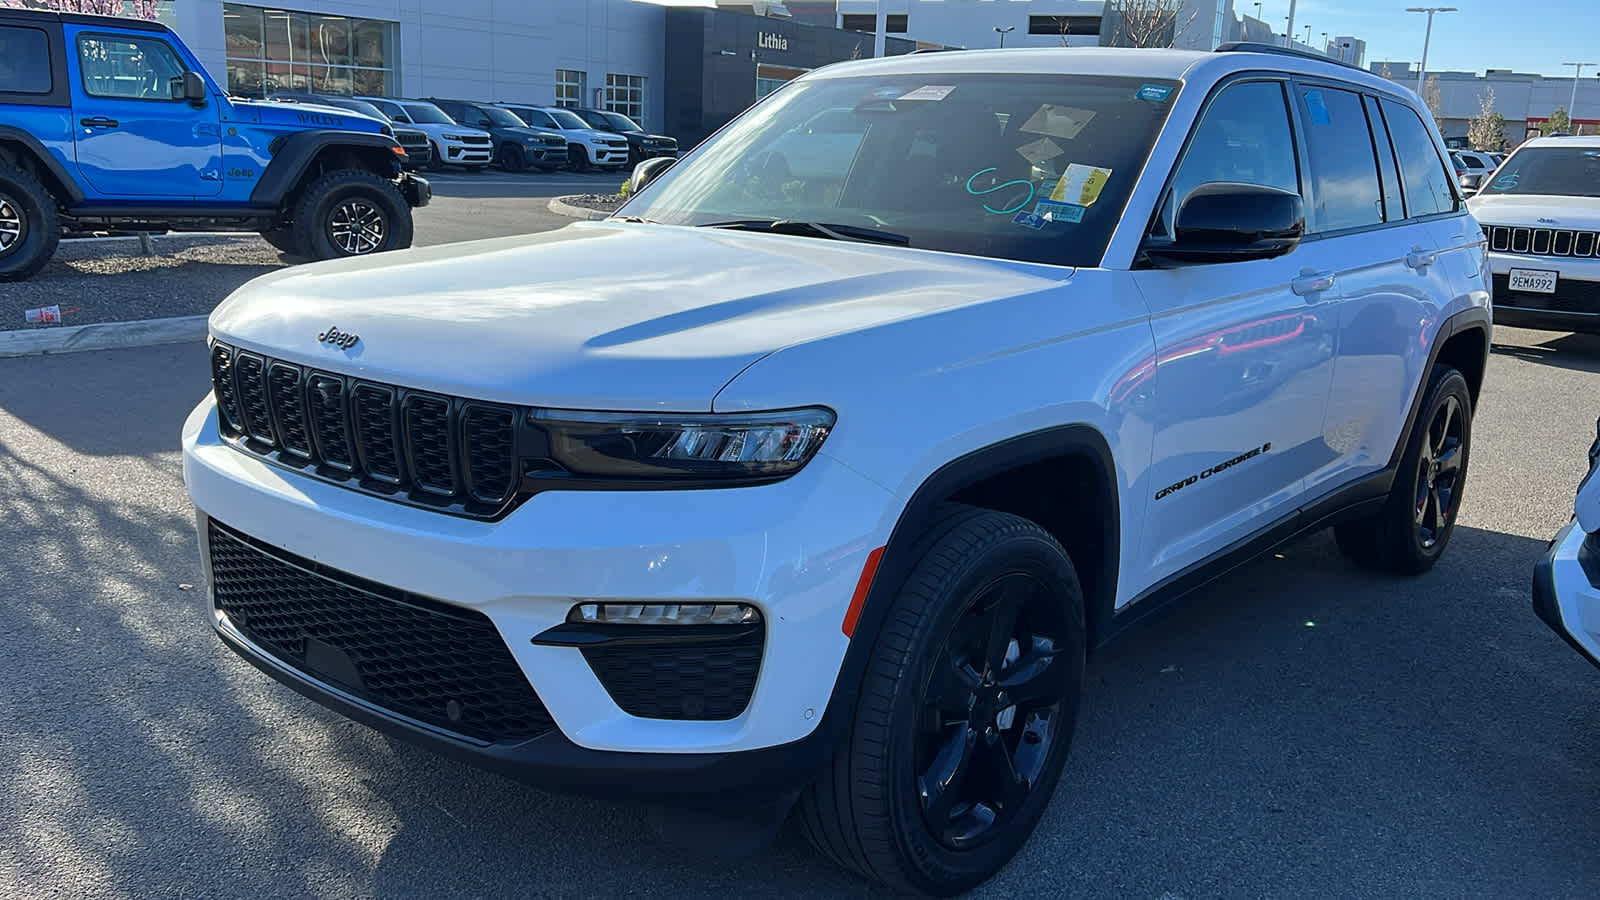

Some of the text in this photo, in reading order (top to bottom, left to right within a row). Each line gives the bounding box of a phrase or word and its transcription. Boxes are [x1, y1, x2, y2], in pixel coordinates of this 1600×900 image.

[758, 31, 788, 50] Lithia
[296, 111, 343, 126] WILLYS
[227, 168, 254, 178] Jeep
[1512, 276, 1553, 290] 9EMA992
[318, 325, 360, 351] Jeep
[1155, 447, 1262, 501] GRAND CHEROKEE
